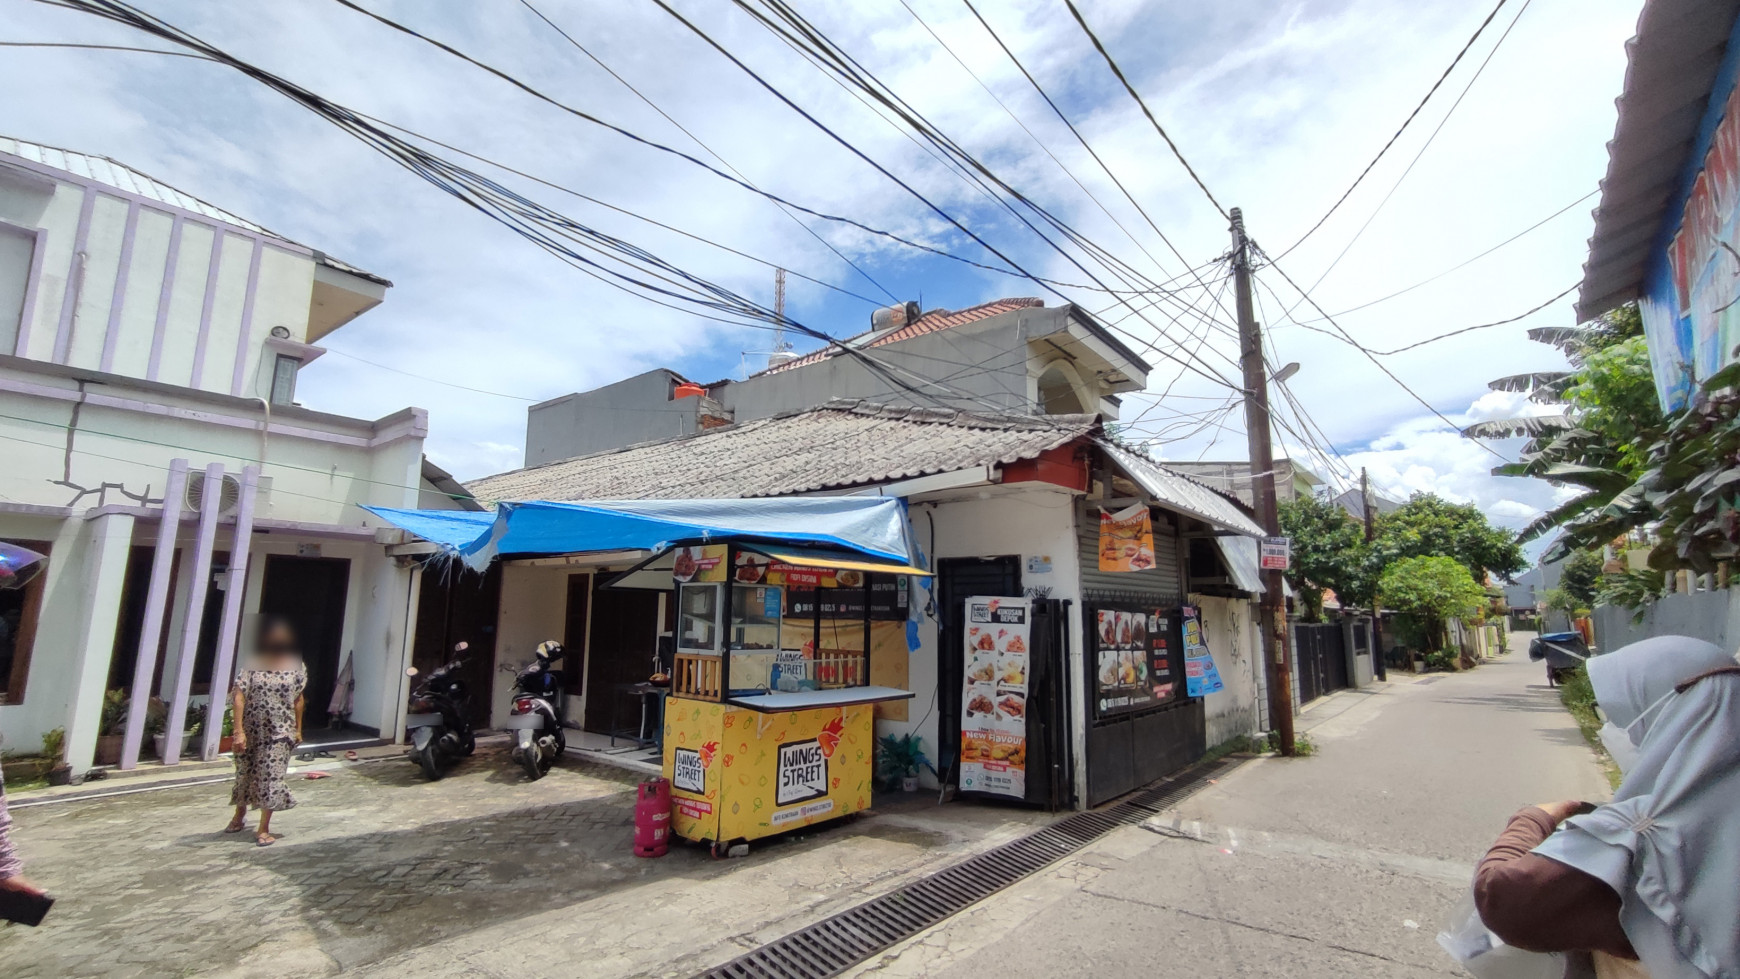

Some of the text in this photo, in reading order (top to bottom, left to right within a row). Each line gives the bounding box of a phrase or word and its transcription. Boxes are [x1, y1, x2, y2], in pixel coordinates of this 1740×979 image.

[966, 732, 1022, 745] New Flavour
[677, 753, 701, 768] WINGS
[783, 746, 821, 768] WINGS
[677, 765, 701, 781] STREET
[783, 764, 821, 787] STREET
